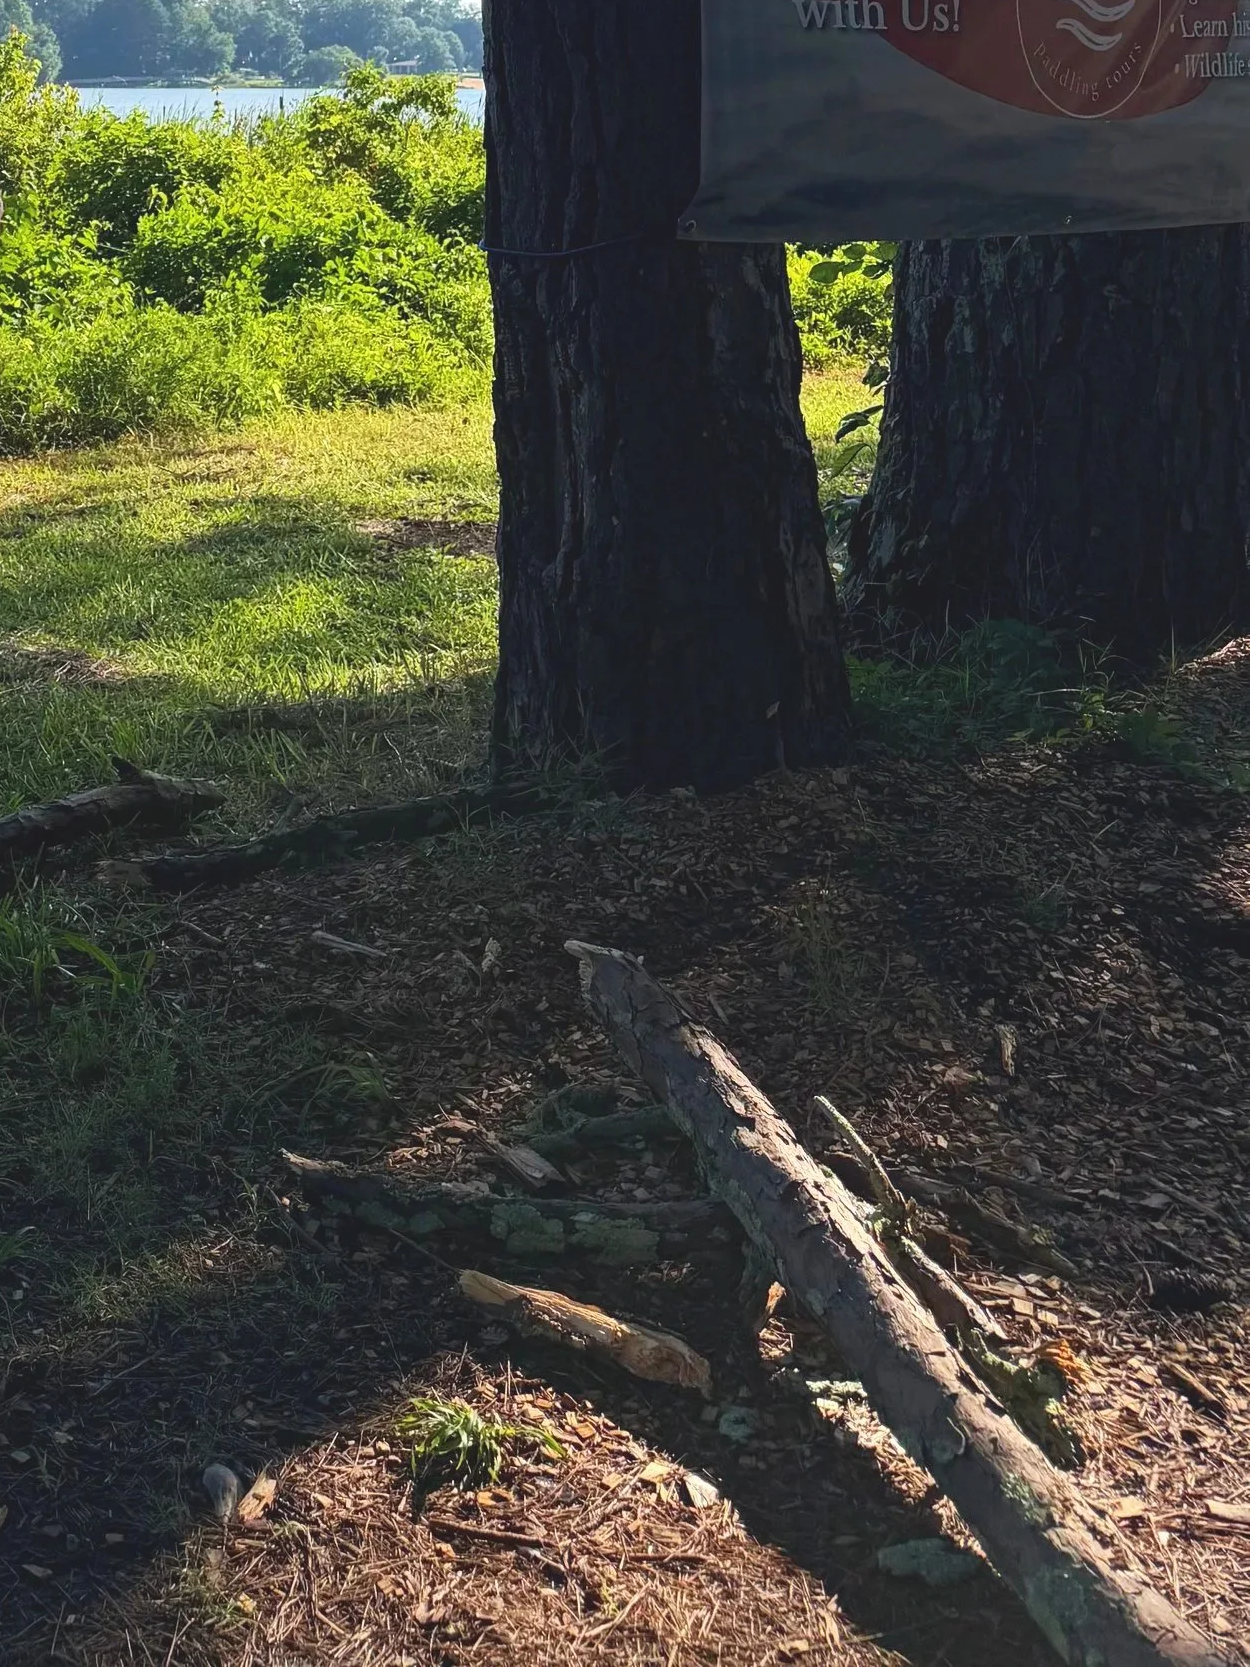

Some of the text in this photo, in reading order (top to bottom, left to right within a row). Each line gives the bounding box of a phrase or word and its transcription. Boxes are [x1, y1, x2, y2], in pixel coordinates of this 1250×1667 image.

[1179, 14, 1228, 38] Learn
[1106, 42, 1142, 89] tours
[1184, 52, 1246, 78] Wildlife
